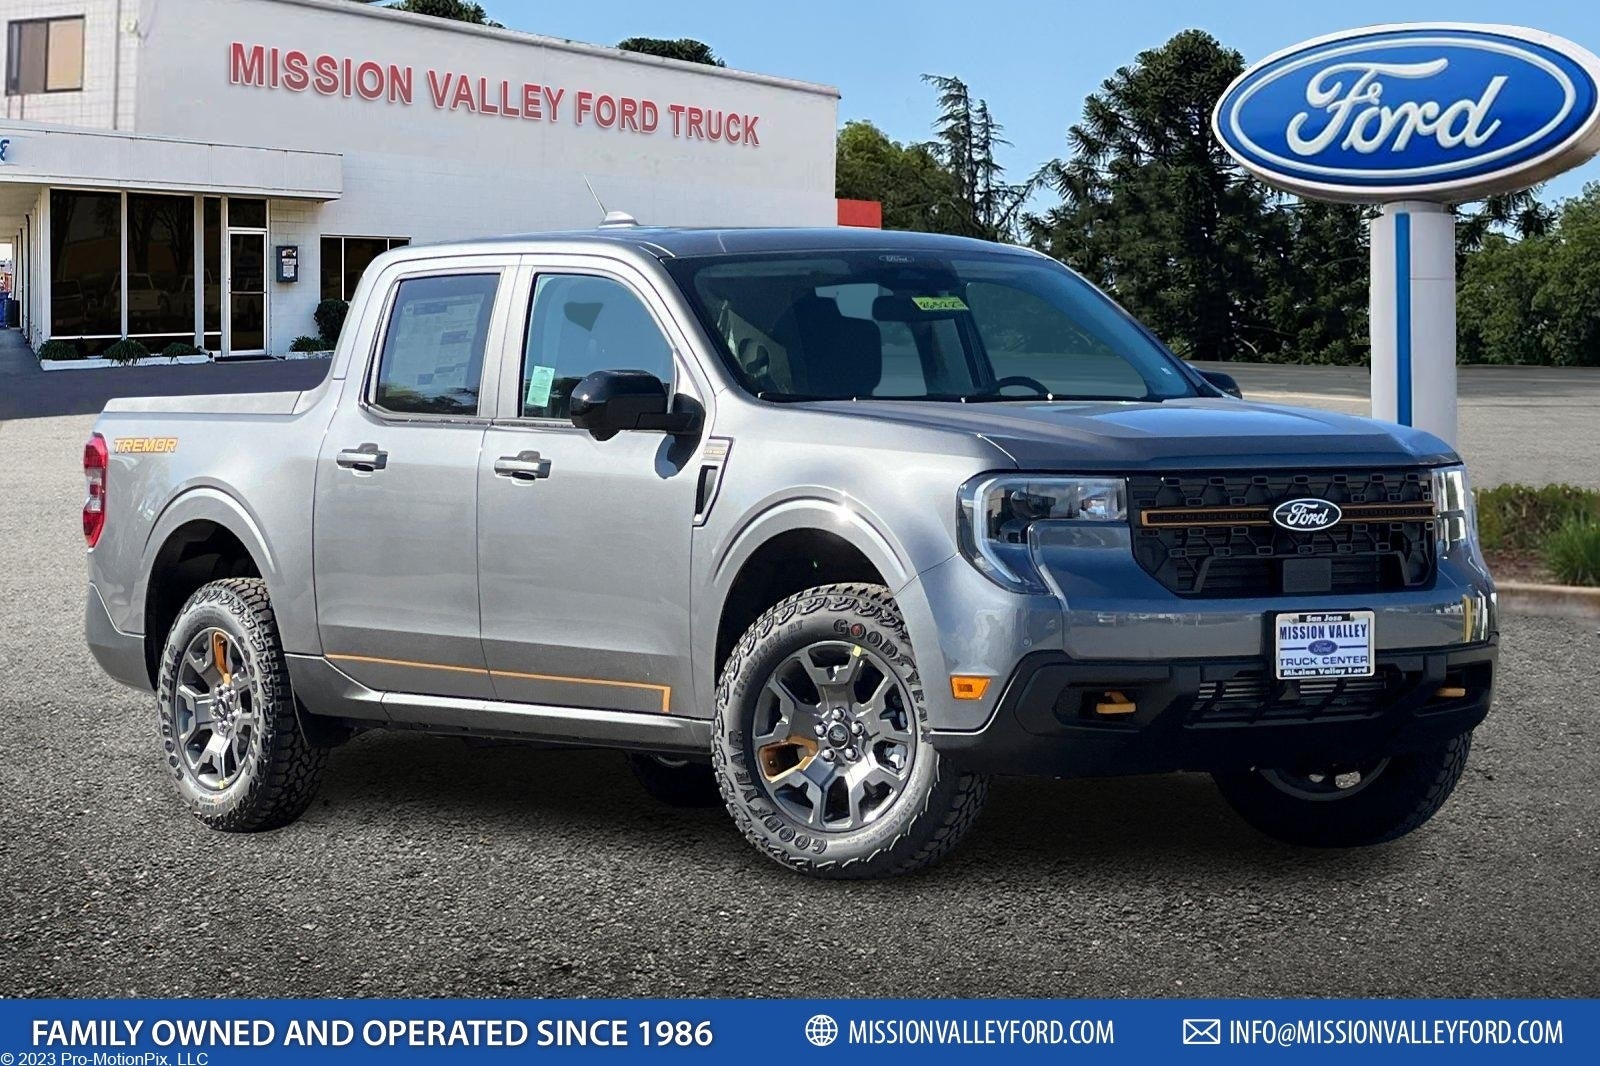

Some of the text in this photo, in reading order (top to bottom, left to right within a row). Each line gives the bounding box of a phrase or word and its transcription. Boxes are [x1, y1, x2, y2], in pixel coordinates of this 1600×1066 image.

[230, 42, 760, 146] MISSION VALLEY FORD TRUCK
[1286, 58, 1508, 156] Ford
[114, 437, 178, 454] TREMOR
[1286, 502, 1329, 526] Ford
[1306, 614, 1322, 622] San
[1280, 623, 1368, 640] MISSION VALLEY
[1280, 655, 1368, 667] TRUCK CENTER
[1318, 667, 1346, 675] Valley
